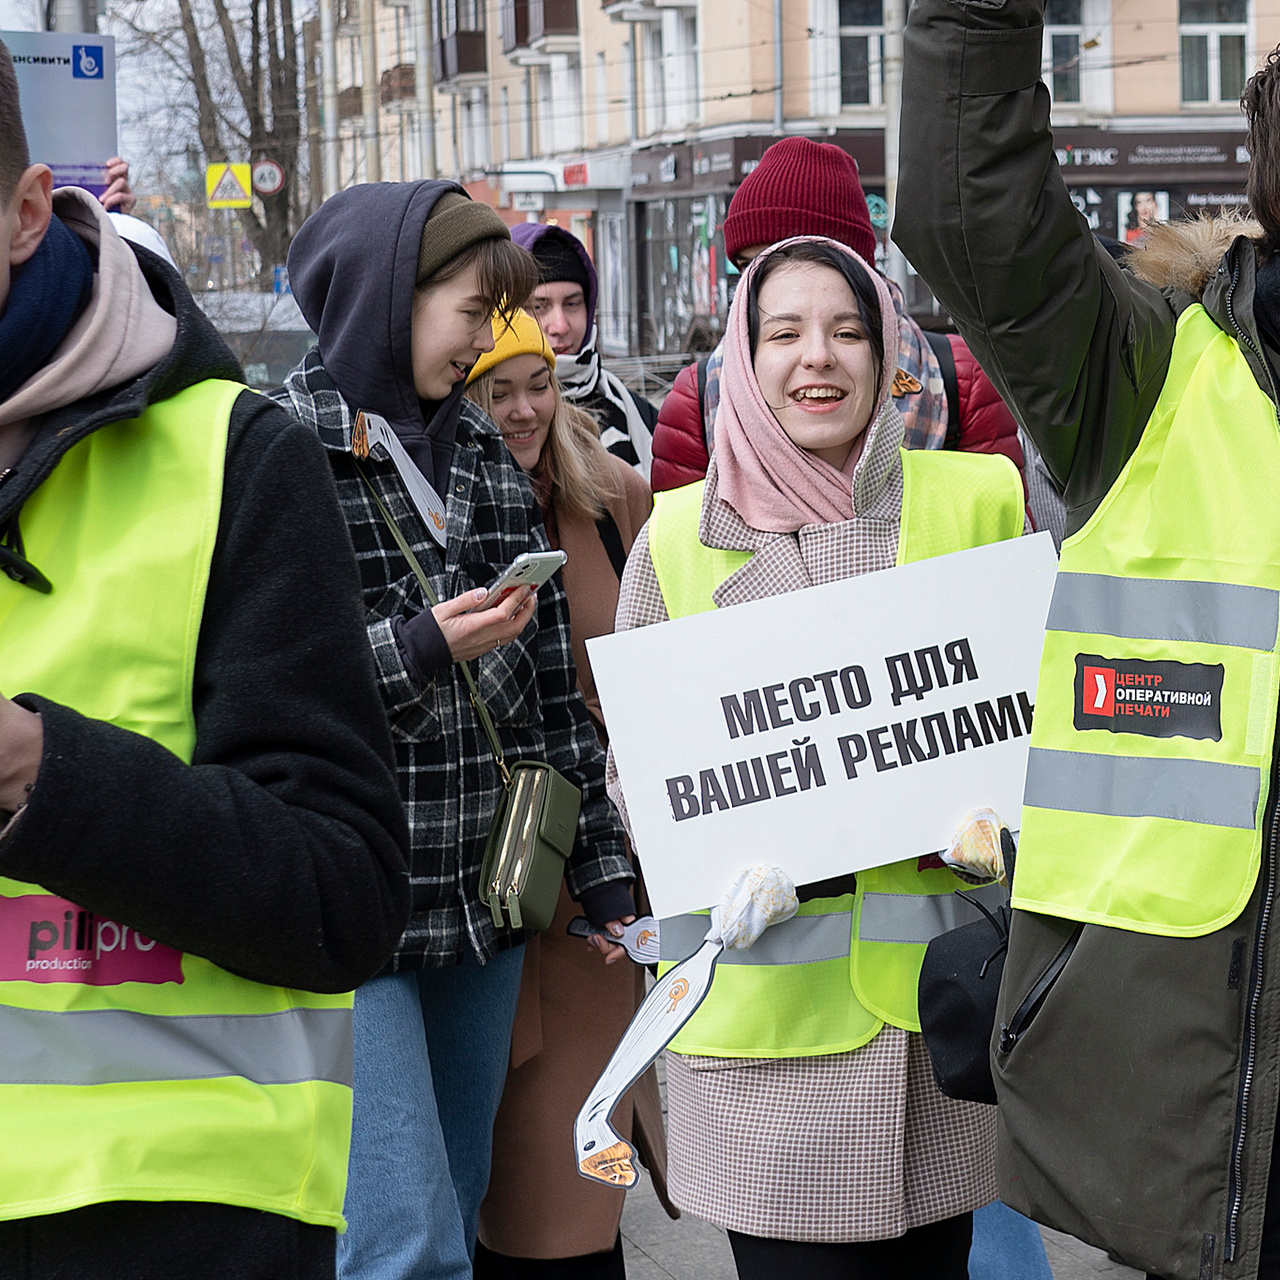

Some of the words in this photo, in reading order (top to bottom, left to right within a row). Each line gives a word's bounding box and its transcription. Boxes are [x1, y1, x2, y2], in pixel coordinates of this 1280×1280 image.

[13, 55, 71, 66] ЕНСИВИТИ
[1115, 671, 1164, 687] ЦЕНТР
[719, 664, 873, 740] МЕСТО
[883, 637, 980, 707] ДЛЯ
[1115, 686, 1213, 706] ОПЕРАТИВНОЙ
[1115, 703, 1171, 718] ПЕЧАТИ
[664, 735, 827, 822] ВАШЕЙ
